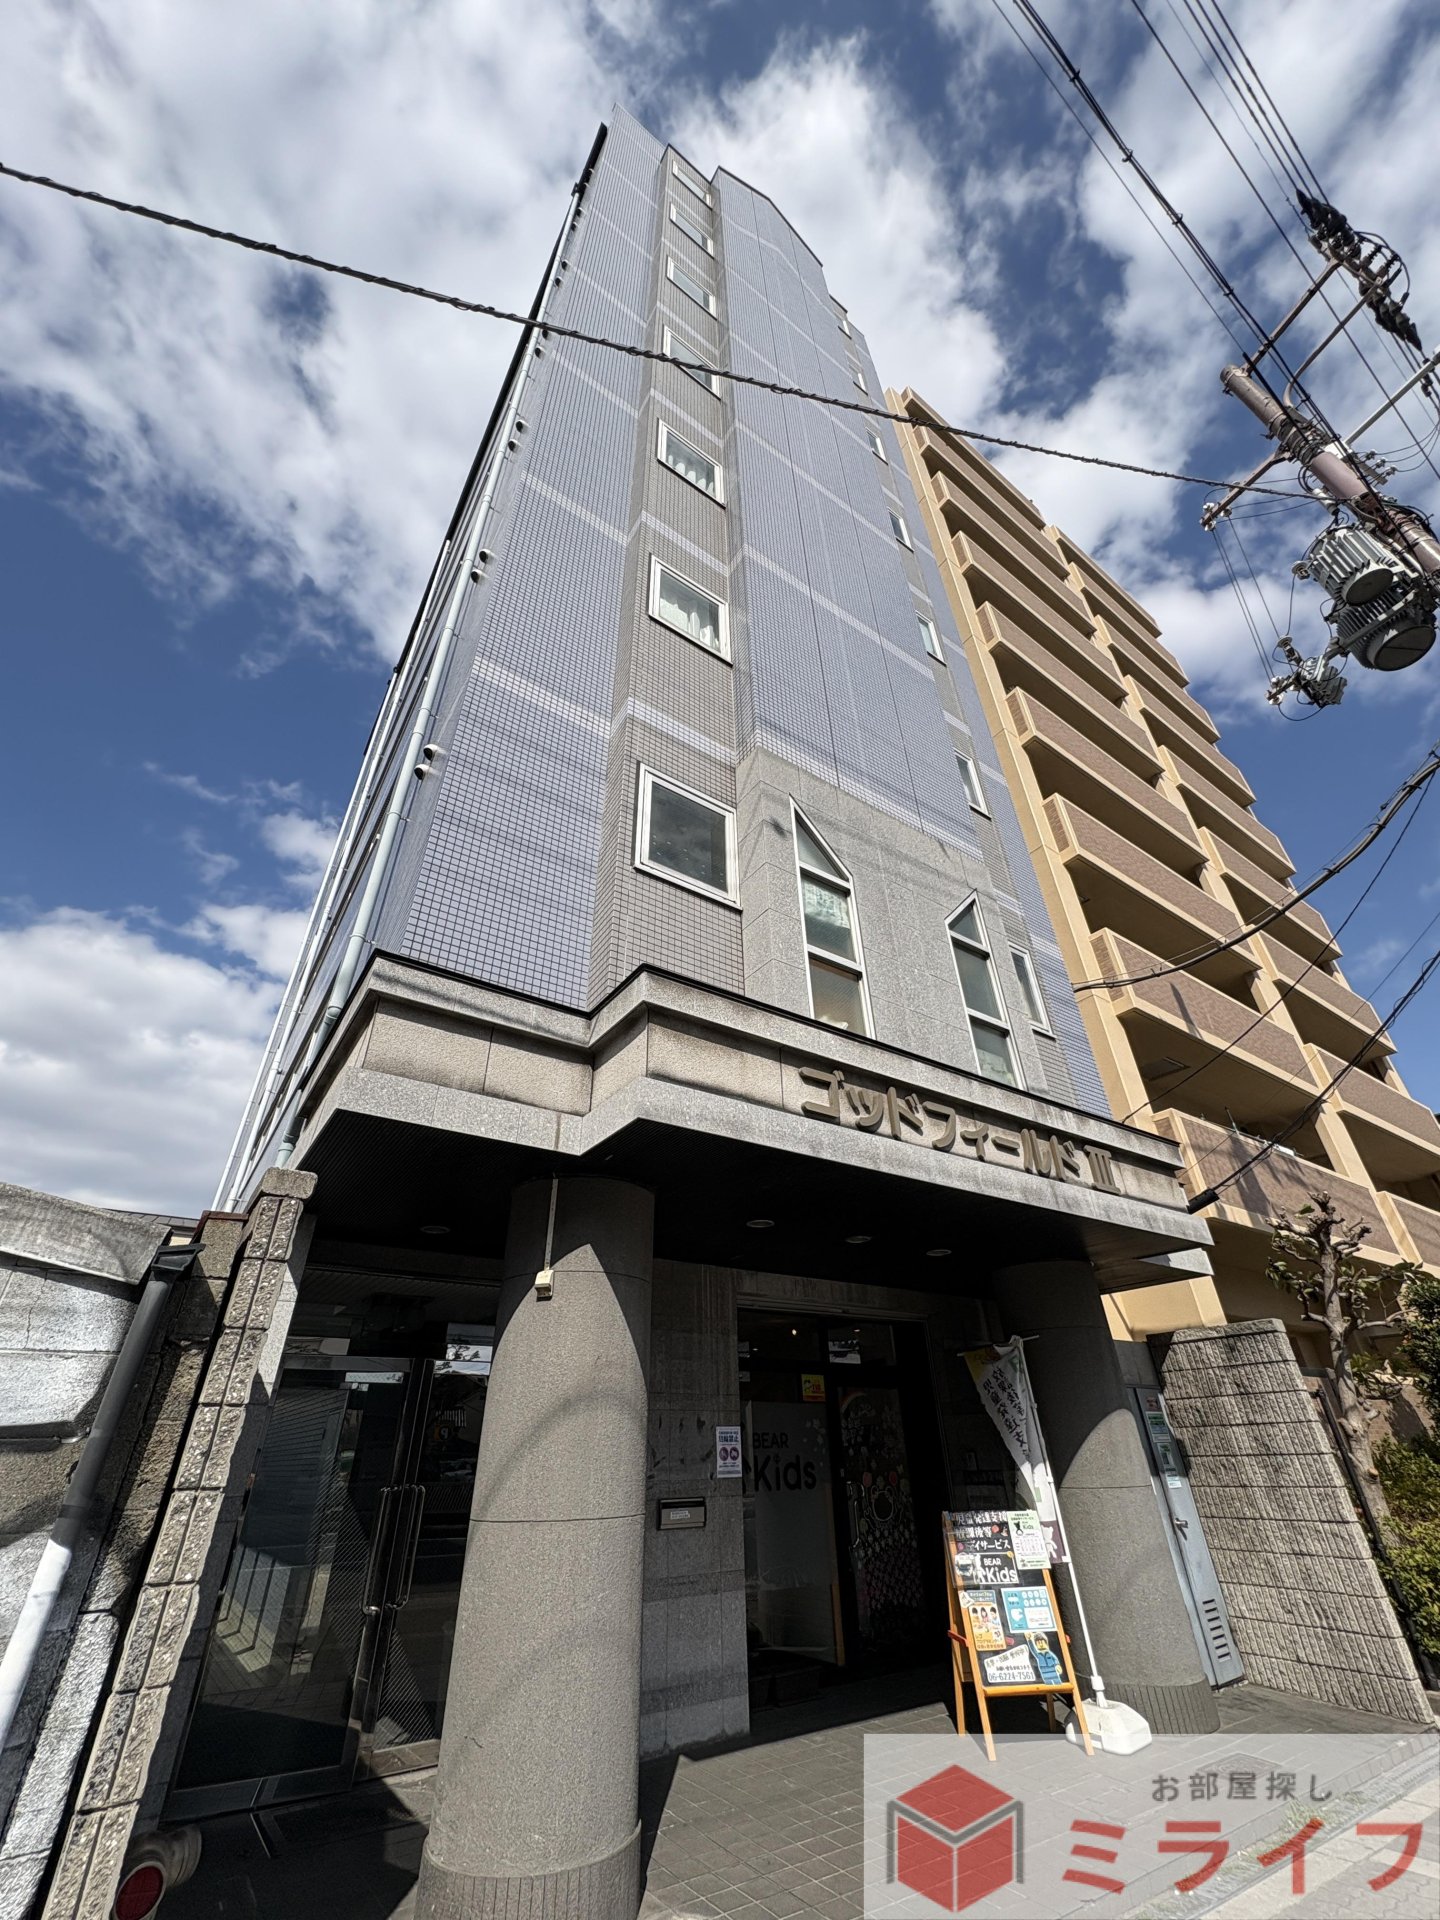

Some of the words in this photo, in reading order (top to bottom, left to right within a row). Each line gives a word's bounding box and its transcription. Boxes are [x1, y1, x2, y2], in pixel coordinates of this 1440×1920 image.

[753, 1432, 789, 1449] BEAR
[753, 1453, 817, 1492] Kids
[968, 1538, 1012, 1551] デイサービス
[983, 1557, 1002, 1567] BEAR
[986, 1566, 1019, 1583] Kids
[988, 1671, 1036, 1682] 06-6224-7561
